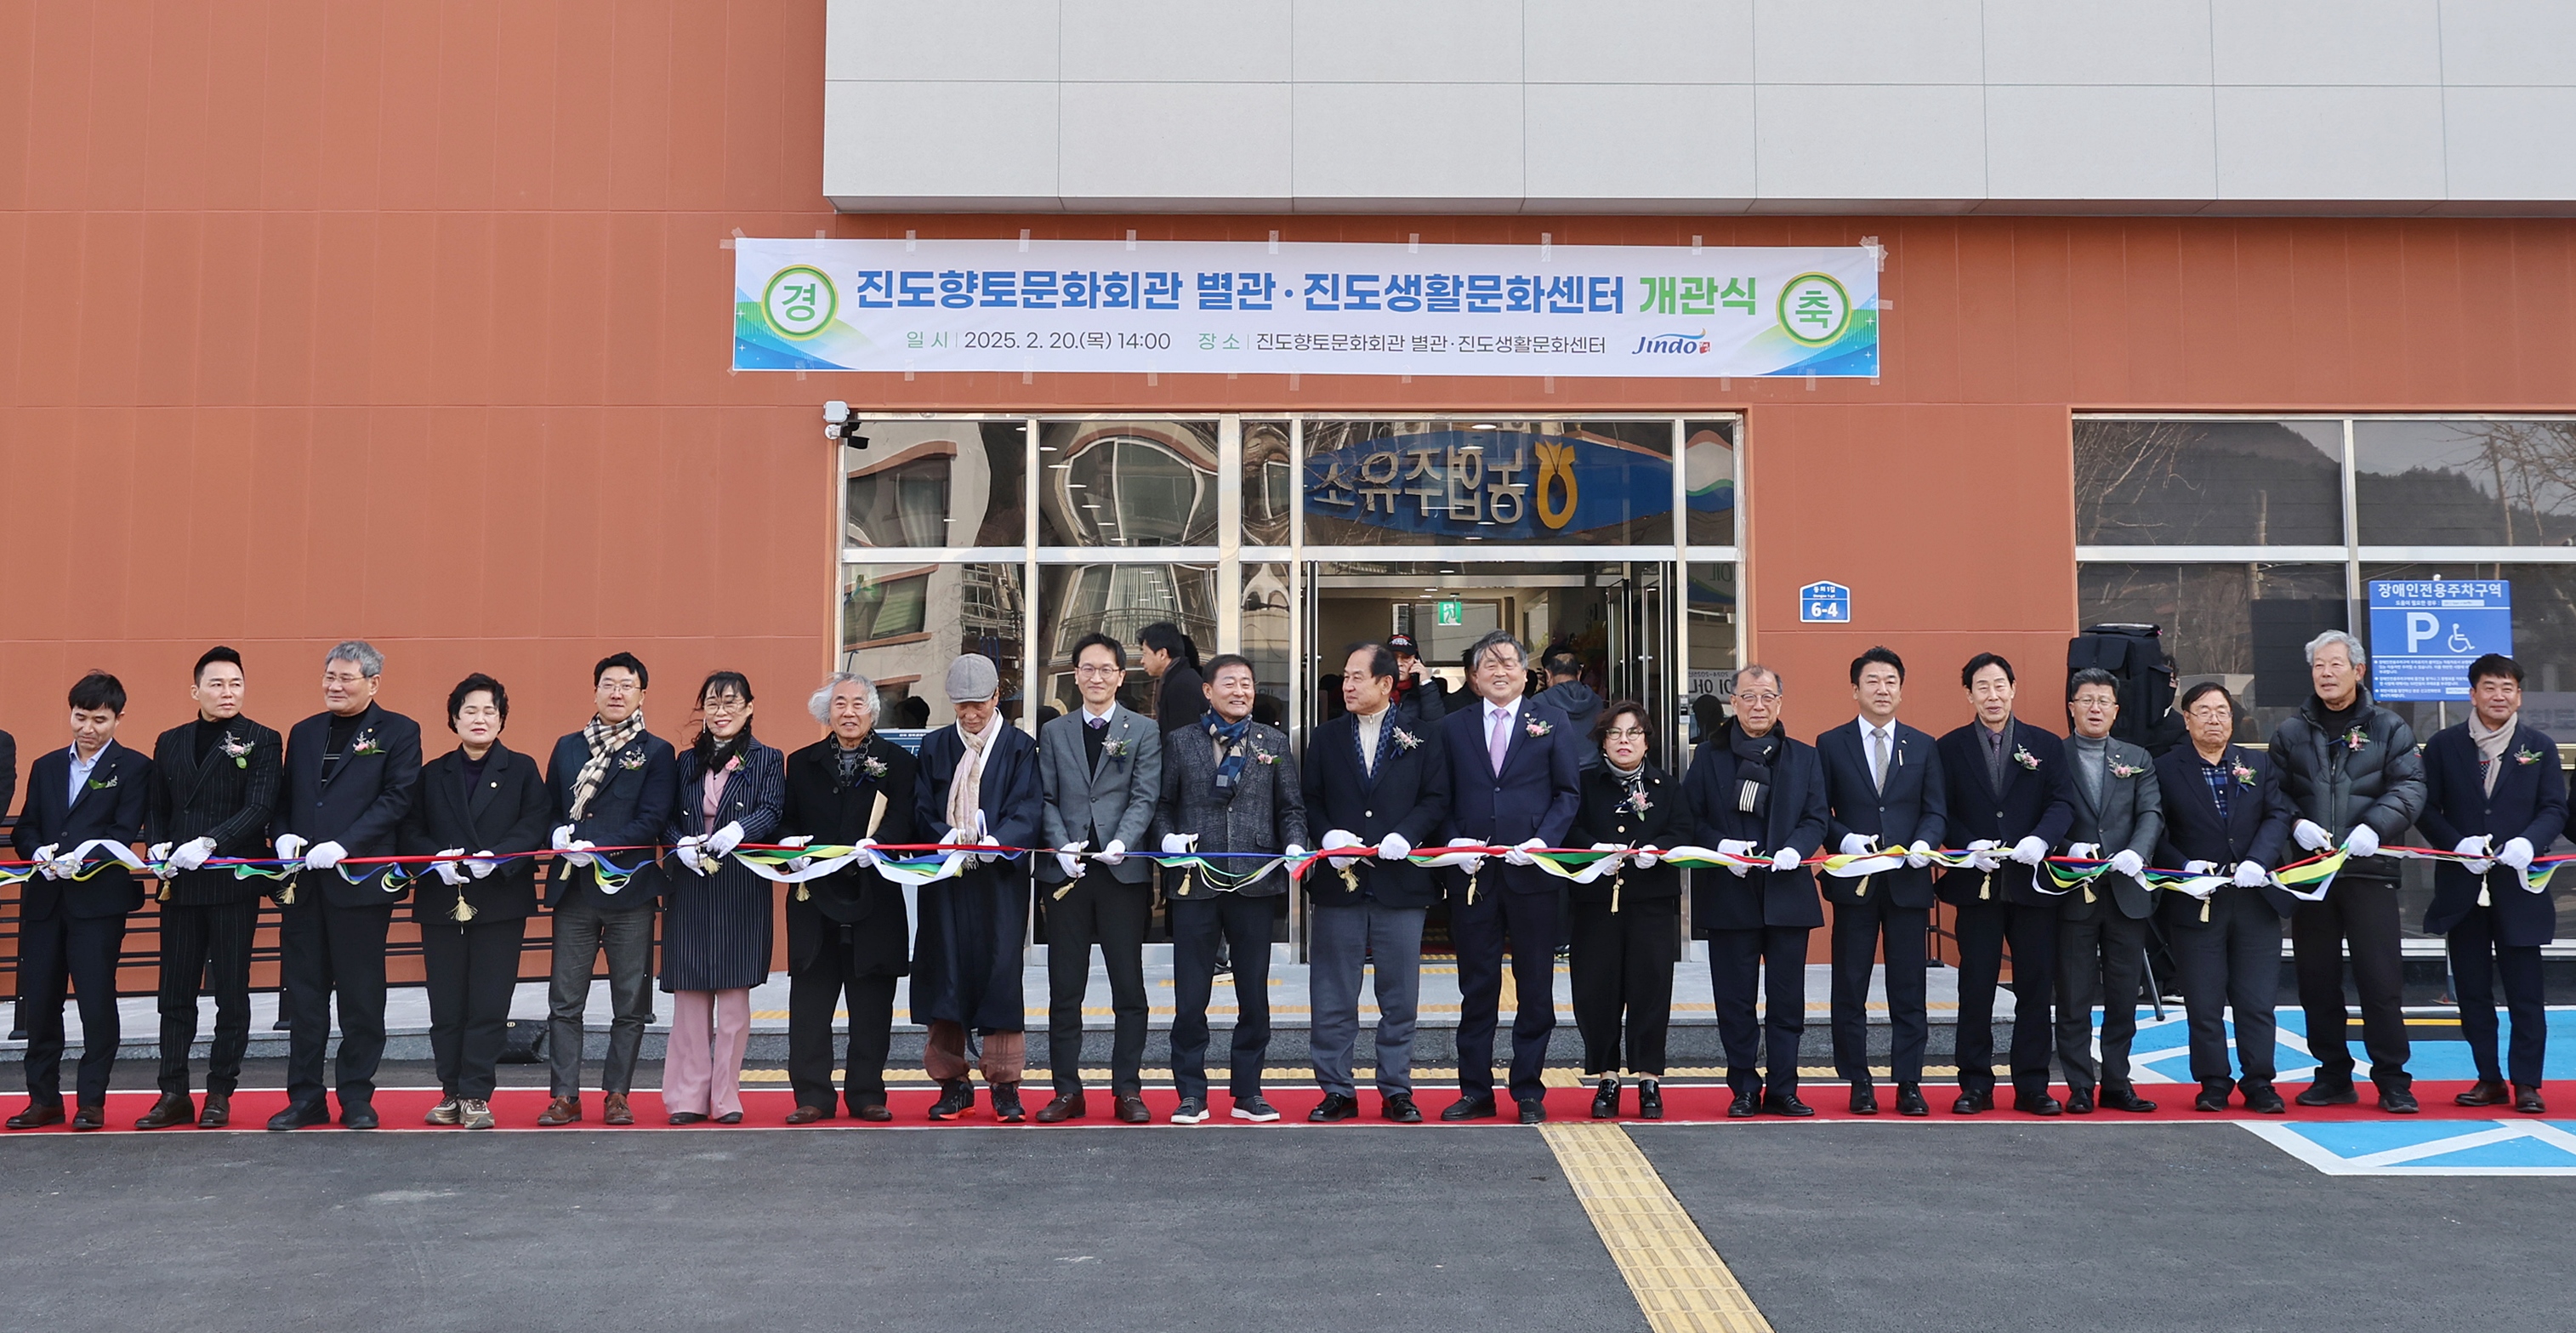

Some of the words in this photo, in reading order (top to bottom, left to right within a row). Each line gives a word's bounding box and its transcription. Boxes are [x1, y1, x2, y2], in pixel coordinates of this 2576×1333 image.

[781, 282, 817, 322] 경
[857, 270, 1183, 310] 진도향토문화회관
[1640, 276, 1756, 316] 개관식
[1794, 289, 1834, 330] 축
[964, 331, 1021, 349] 2025.
[1026, 331, 1043, 349] 2.
[1117, 331, 1171, 350] 14:00
[1256, 333, 1406, 352] 진도향토문화회관
[1631, 336, 1697, 355] Jindo
[2378, 583, 2502, 598] 장애인전용주차구역
[1811, 601, 1839, 618] 6-4
[2406, 612, 2440, 653] P
